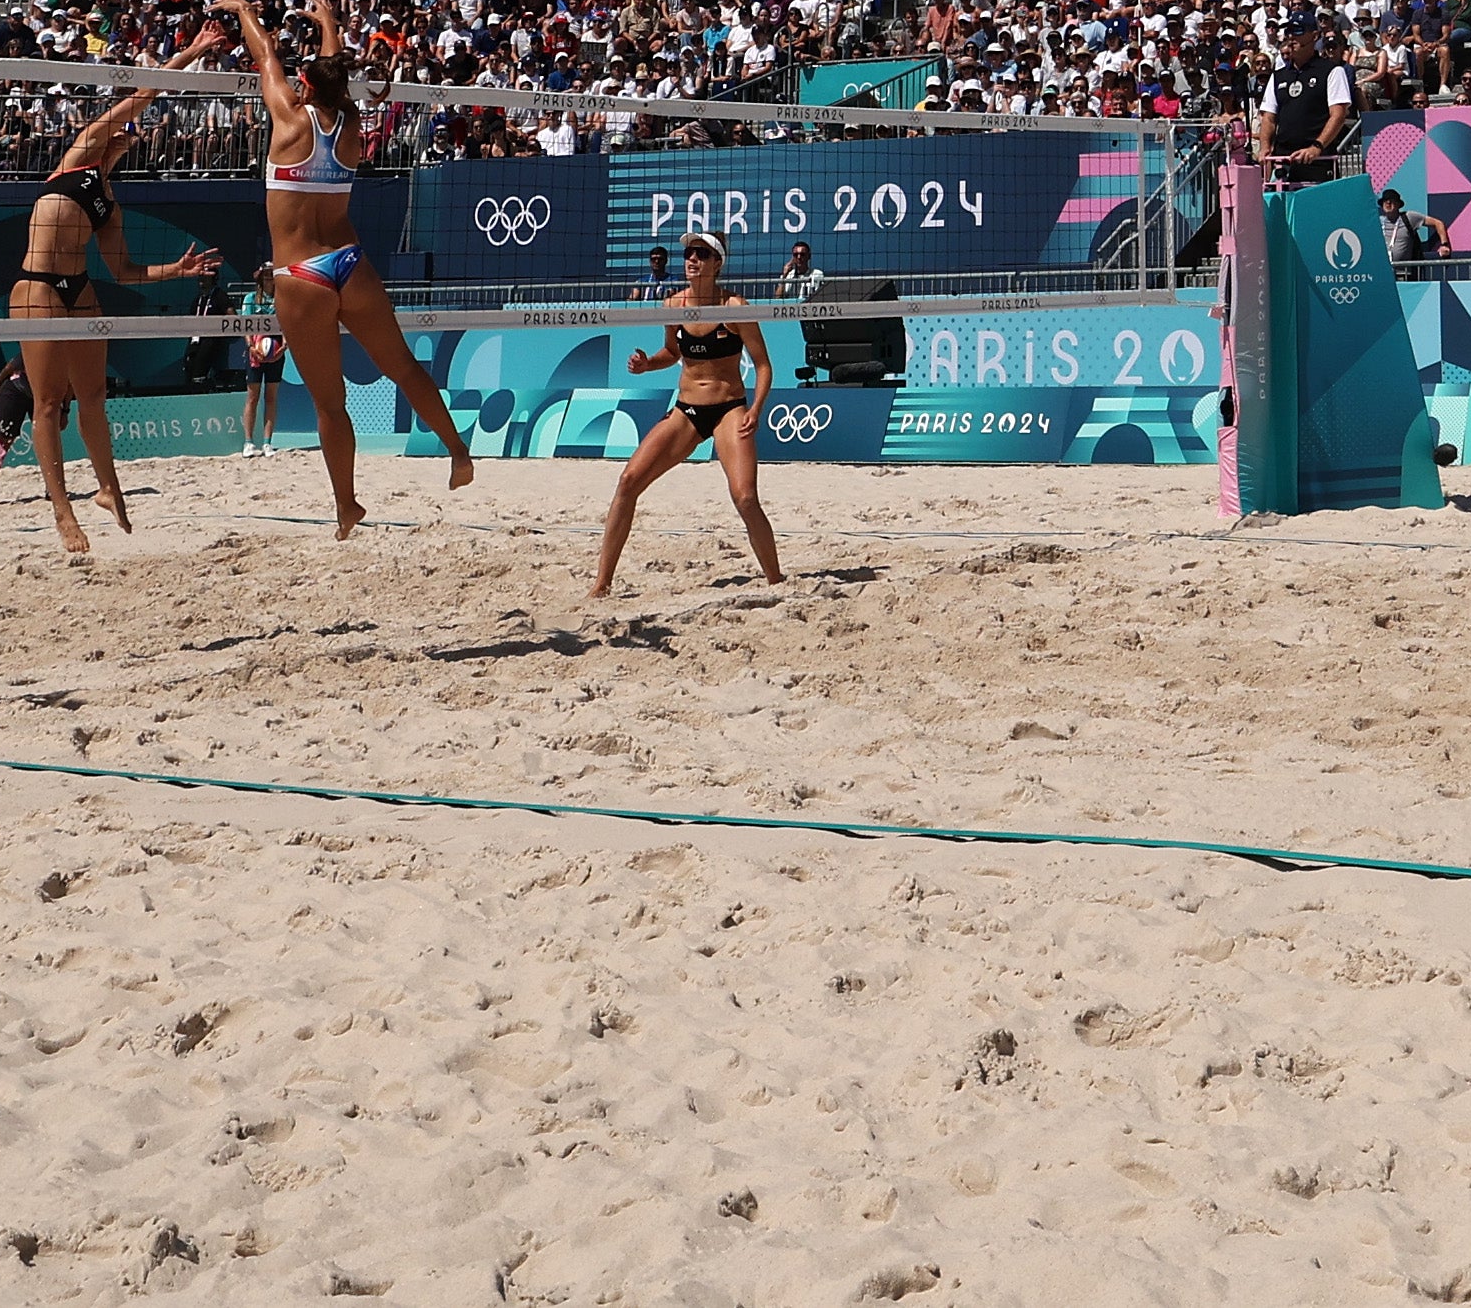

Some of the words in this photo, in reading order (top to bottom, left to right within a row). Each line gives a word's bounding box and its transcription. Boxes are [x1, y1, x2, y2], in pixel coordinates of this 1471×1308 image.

[578, 95, 616, 110] 2024
[814, 107, 844, 121] 2024
[1013, 116, 1039, 127] 2024
[81, 178, 92, 189] 2
[93, 197, 106, 217] GER
[833, 180, 982, 232] 2024
[1347, 273, 1373, 283] 2024
[812, 304, 844, 318] 2024
[1015, 298, 1042, 310] 2024
[571, 311, 607, 325] 2024
[689, 345, 707, 353] GER
[981, 412, 1051, 434] 2024
